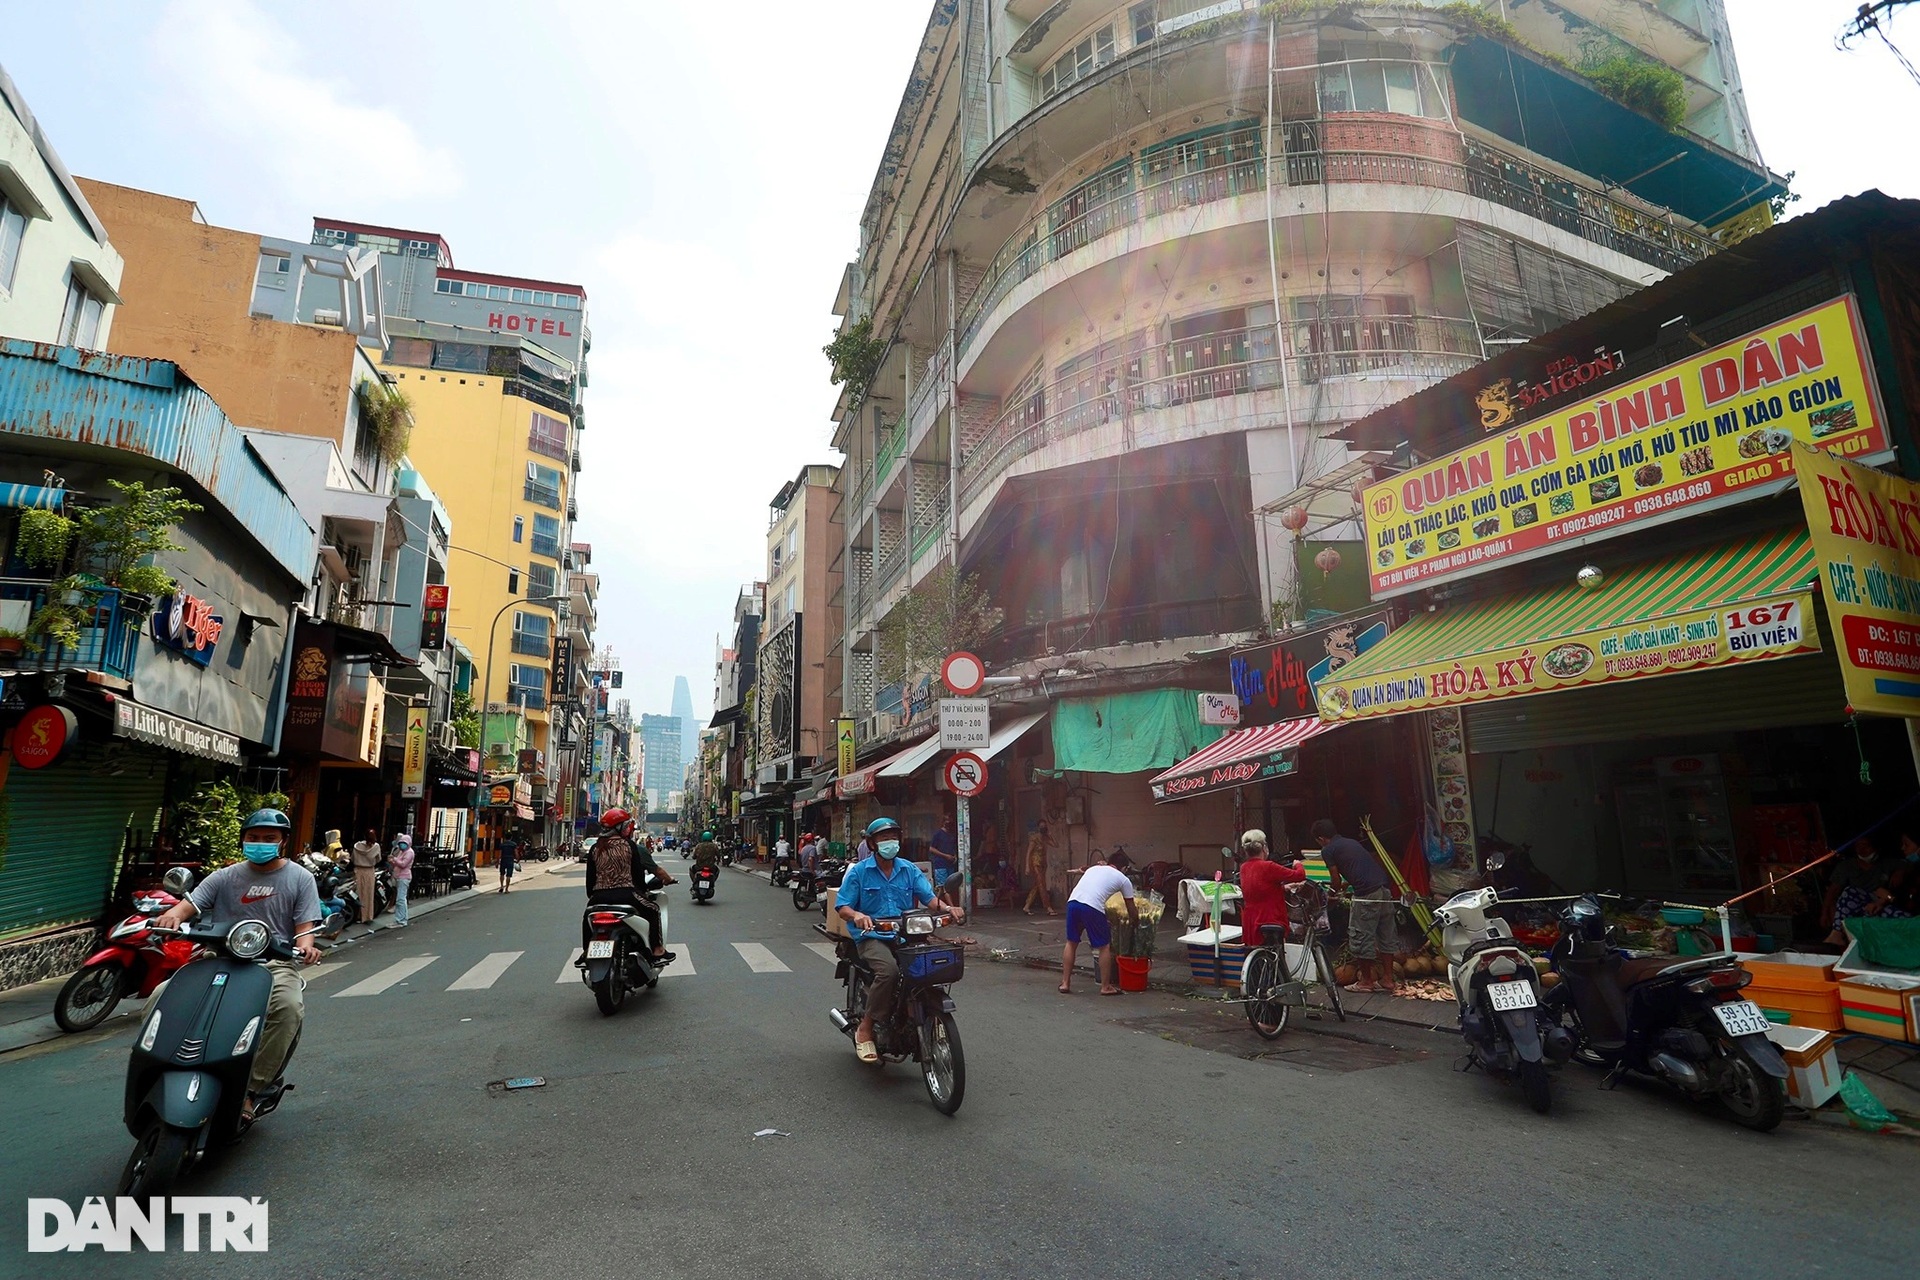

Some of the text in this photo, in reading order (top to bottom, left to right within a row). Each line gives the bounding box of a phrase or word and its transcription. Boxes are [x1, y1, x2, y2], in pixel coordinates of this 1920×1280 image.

[488, 313, 572, 337] HOTEL
[1545, 355, 1579, 375] BIA
[1517, 352, 1617, 409] SAIGON
[1402, 324, 1825, 515] QUÁN ĂN BÌNH DÂN
[1398, 520, 1413, 541] CÁ
[1414, 510, 1443, 535] THÁC
[1444, 503, 1469, 527] LÁC,
[1471, 487, 1497, 517] KHỔ
[1500, 483, 1528, 509] QUA,
[1531, 471, 1562, 498] CƠM
[1566, 460, 1586, 486] GÀ
[1588, 448, 1615, 479] XỐI
[1619, 440, 1649, 468] MỠ,
[1651, 427, 1676, 458] HỦ
[1678, 420, 1710, 448] TÍU
[1713, 407, 1738, 437] MÌ
[1741, 395, 1784, 428] XÀO
[1788, 375, 1843, 414] GIÒN
[1723, 463, 1773, 488] GIAO
[1372, 494, 1394, 517] 167
[1546, 525, 1561, 540] ĐT:
[1561, 504, 1626, 535] 0902.909247
[1633, 479, 1712, 515] 0938.648.860
[1816, 464, 1899, 550] HÒA
[1378, 574, 1390, 588] 167
[1391, 569, 1404, 584] BÙI
[1404, 565, 1420, 582] VIỆN
[1429, 555, 1450, 574] PHẠM
[1451, 549, 1467, 568] NGŨ
[1507, 538, 1513, 551] 1
[1828, 553, 1862, 605] CAFÉ
[184, 594, 223, 651] Tiger
[1727, 601, 1795, 631] 167
[1600, 636, 1618, 656] CAFÉ
[1623, 626, 1643, 651] NƯỚC
[1643, 624, 1660, 648] GIẢI
[1660, 620, 1680, 646] KHÁT
[1686, 620, 1705, 642] SINH
[1704, 612, 1719, 638] TỐ
[1730, 626, 1798, 651] BÙI VIỆN
[1868, 624, 1890, 643] ĐC:
[1893, 629, 1912, 647] 167
[556, 640, 568, 692] MERAKI
[1605, 660, 1617, 674] ĐT:
[1617, 651, 1662, 673] 0938.648.860
[1668, 643, 1717, 665] 0902.909.247
[1857, 647, 1874, 665] ĐT:
[1231, 647, 1308, 710] Kim Mây
[1351, 649, 1539, 711] QUÁN ĂN BÌNH DÂN HÒA KÝ
[291, 687, 325, 698] JANE
[551, 693, 567, 702] HOTEL
[1206, 695, 1224, 708] Kim
[292, 710, 323, 719] T-SHIRT
[942, 704, 951, 713] THỨ
[956, 703, 963, 713] VÀ
[974, 703, 986, 714] NHẬT
[1219, 705, 1239, 720] Mây
[134, 708, 167, 738] Little
[212, 733, 239, 758] Coffee
[21, 746, 48, 756] SAIGON
[1165, 762, 1261, 796] Kim Mây
[247, 885, 274, 896] RUN
[1493, 983, 1525, 996] 59-F1
[1495, 993, 1534, 1010] 833.40
[1720, 1003, 1756, 1020] 59-T2
[1728, 1017, 1769, 1035] 233.76
